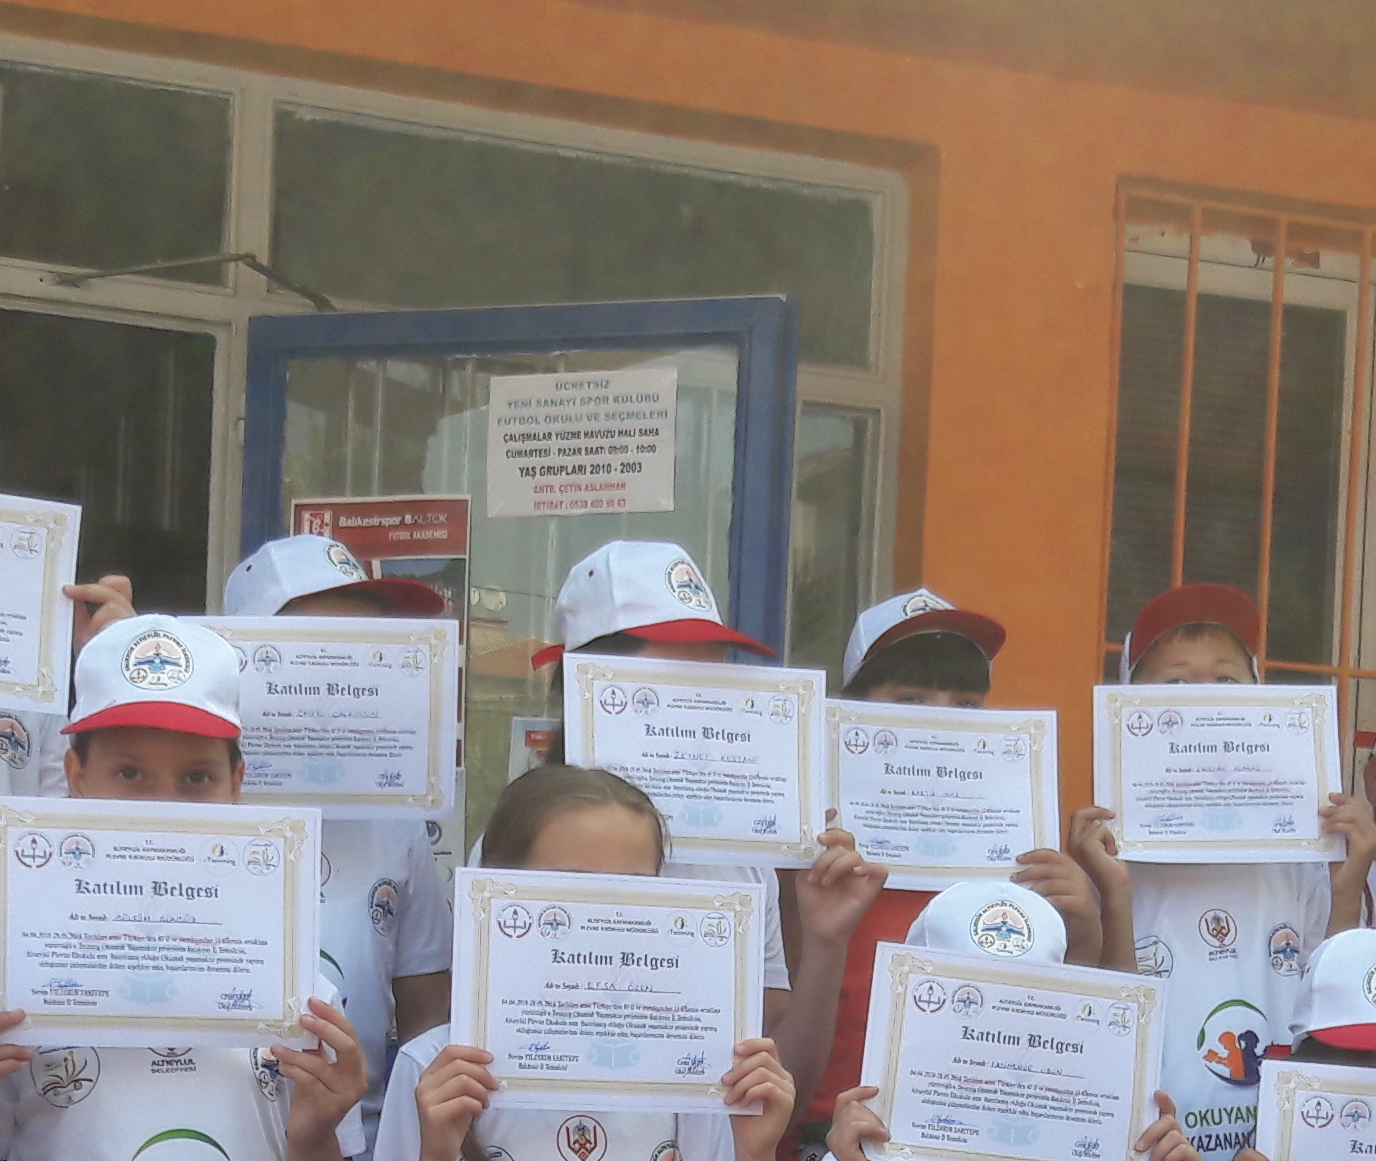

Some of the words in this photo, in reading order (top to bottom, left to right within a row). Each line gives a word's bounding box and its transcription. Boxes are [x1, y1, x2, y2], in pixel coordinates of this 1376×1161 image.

[580, 395, 609, 407] SPOR
[544, 413, 582, 425] OKULU
[586, 413, 600, 422] VE
[638, 427, 660, 437] SAHA
[557, 446, 583, 458] PAZAR
[518, 466, 537, 480] YAŞ
[539, 464, 587, 478] GRUPLARI
[589, 463, 612, 475] 2010
[620, 462, 642, 474] 2003
[644, 724, 697, 739] Katılım
[701, 726, 751, 744] Belgesi
[883, 763, 931, 778] Katılım
[936, 766, 983, 781] Belgesi
[74, 878, 143, 898] Katılım
[150, 881, 219, 901] Belgesi
[550, 949, 613, 967] Katılım
[619, 952, 680, 972] Belgesi
[961, 1025, 1020, 1046] Katılım
[1027, 1033, 1084, 1055] Belgesi
[1185, 1105, 1257, 1129] OKUYAN
